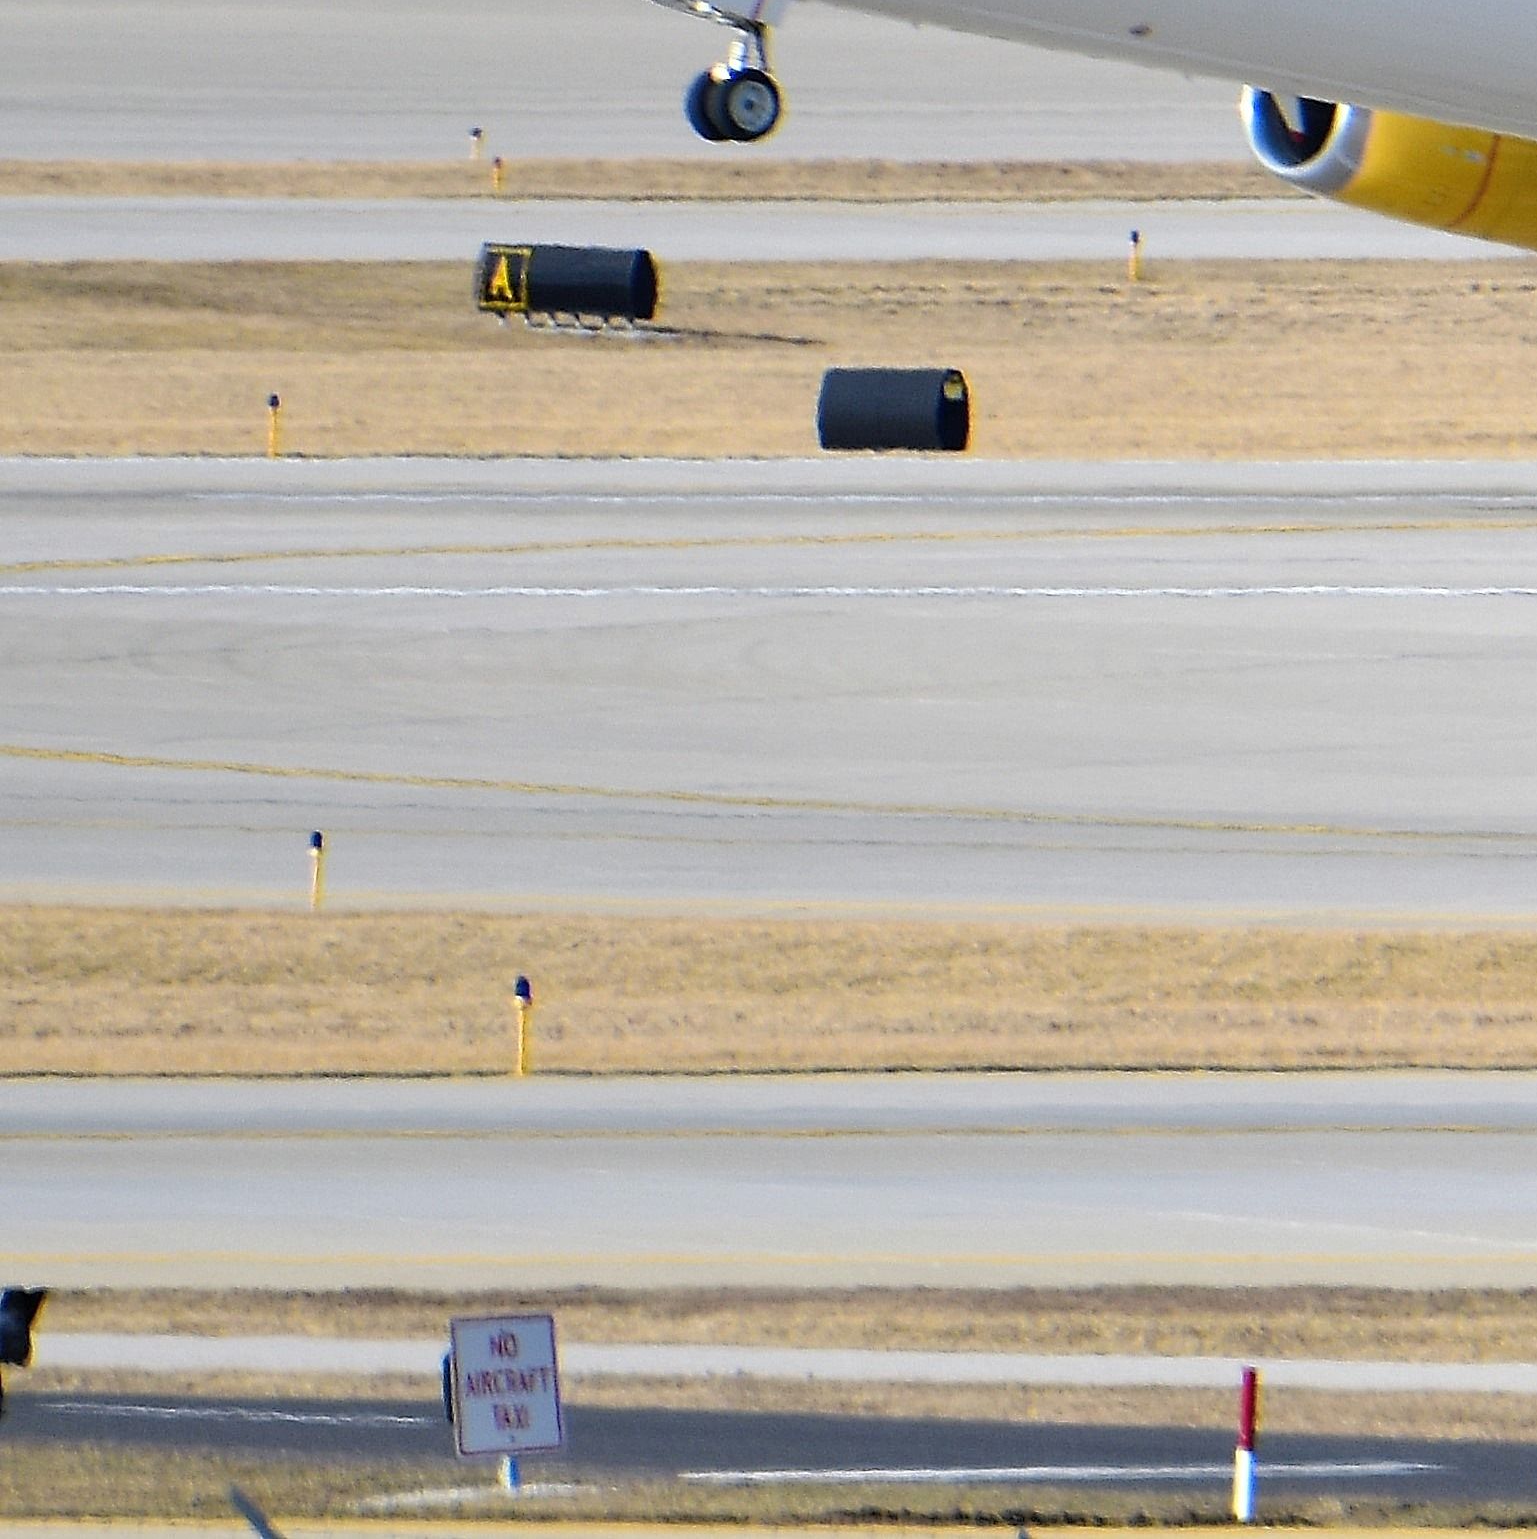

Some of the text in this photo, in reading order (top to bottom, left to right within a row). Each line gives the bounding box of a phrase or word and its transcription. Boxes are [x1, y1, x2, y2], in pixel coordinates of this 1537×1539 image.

[490, 255, 513, 300] A
[489, 1329, 518, 1358] NO
[465, 1365, 551, 1398] AIRCRAFT
[493, 1402, 531, 1430] TAXI
